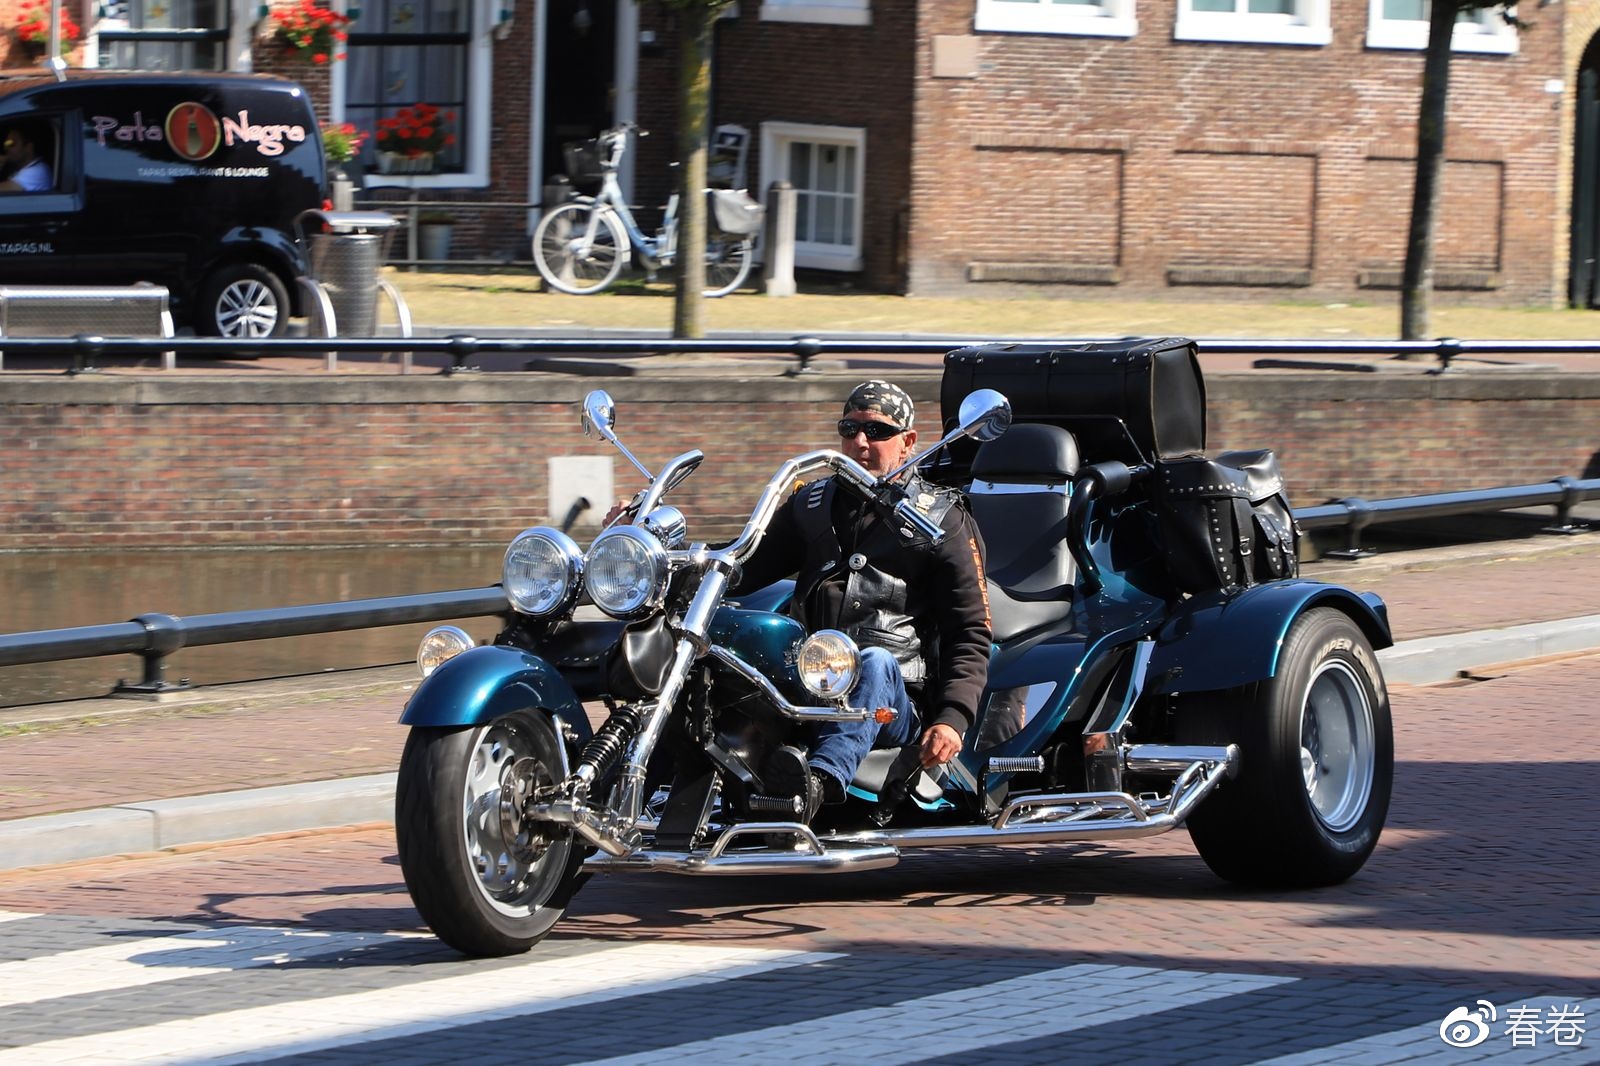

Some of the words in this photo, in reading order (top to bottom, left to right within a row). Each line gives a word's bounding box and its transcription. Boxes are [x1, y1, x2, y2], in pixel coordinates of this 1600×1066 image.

[91, 111, 163, 147] Pata
[222, 110, 305, 156] Negra
[232, 167, 270, 177] LOUNGE
[0, 243, 54, 254] TAPAS.NL
